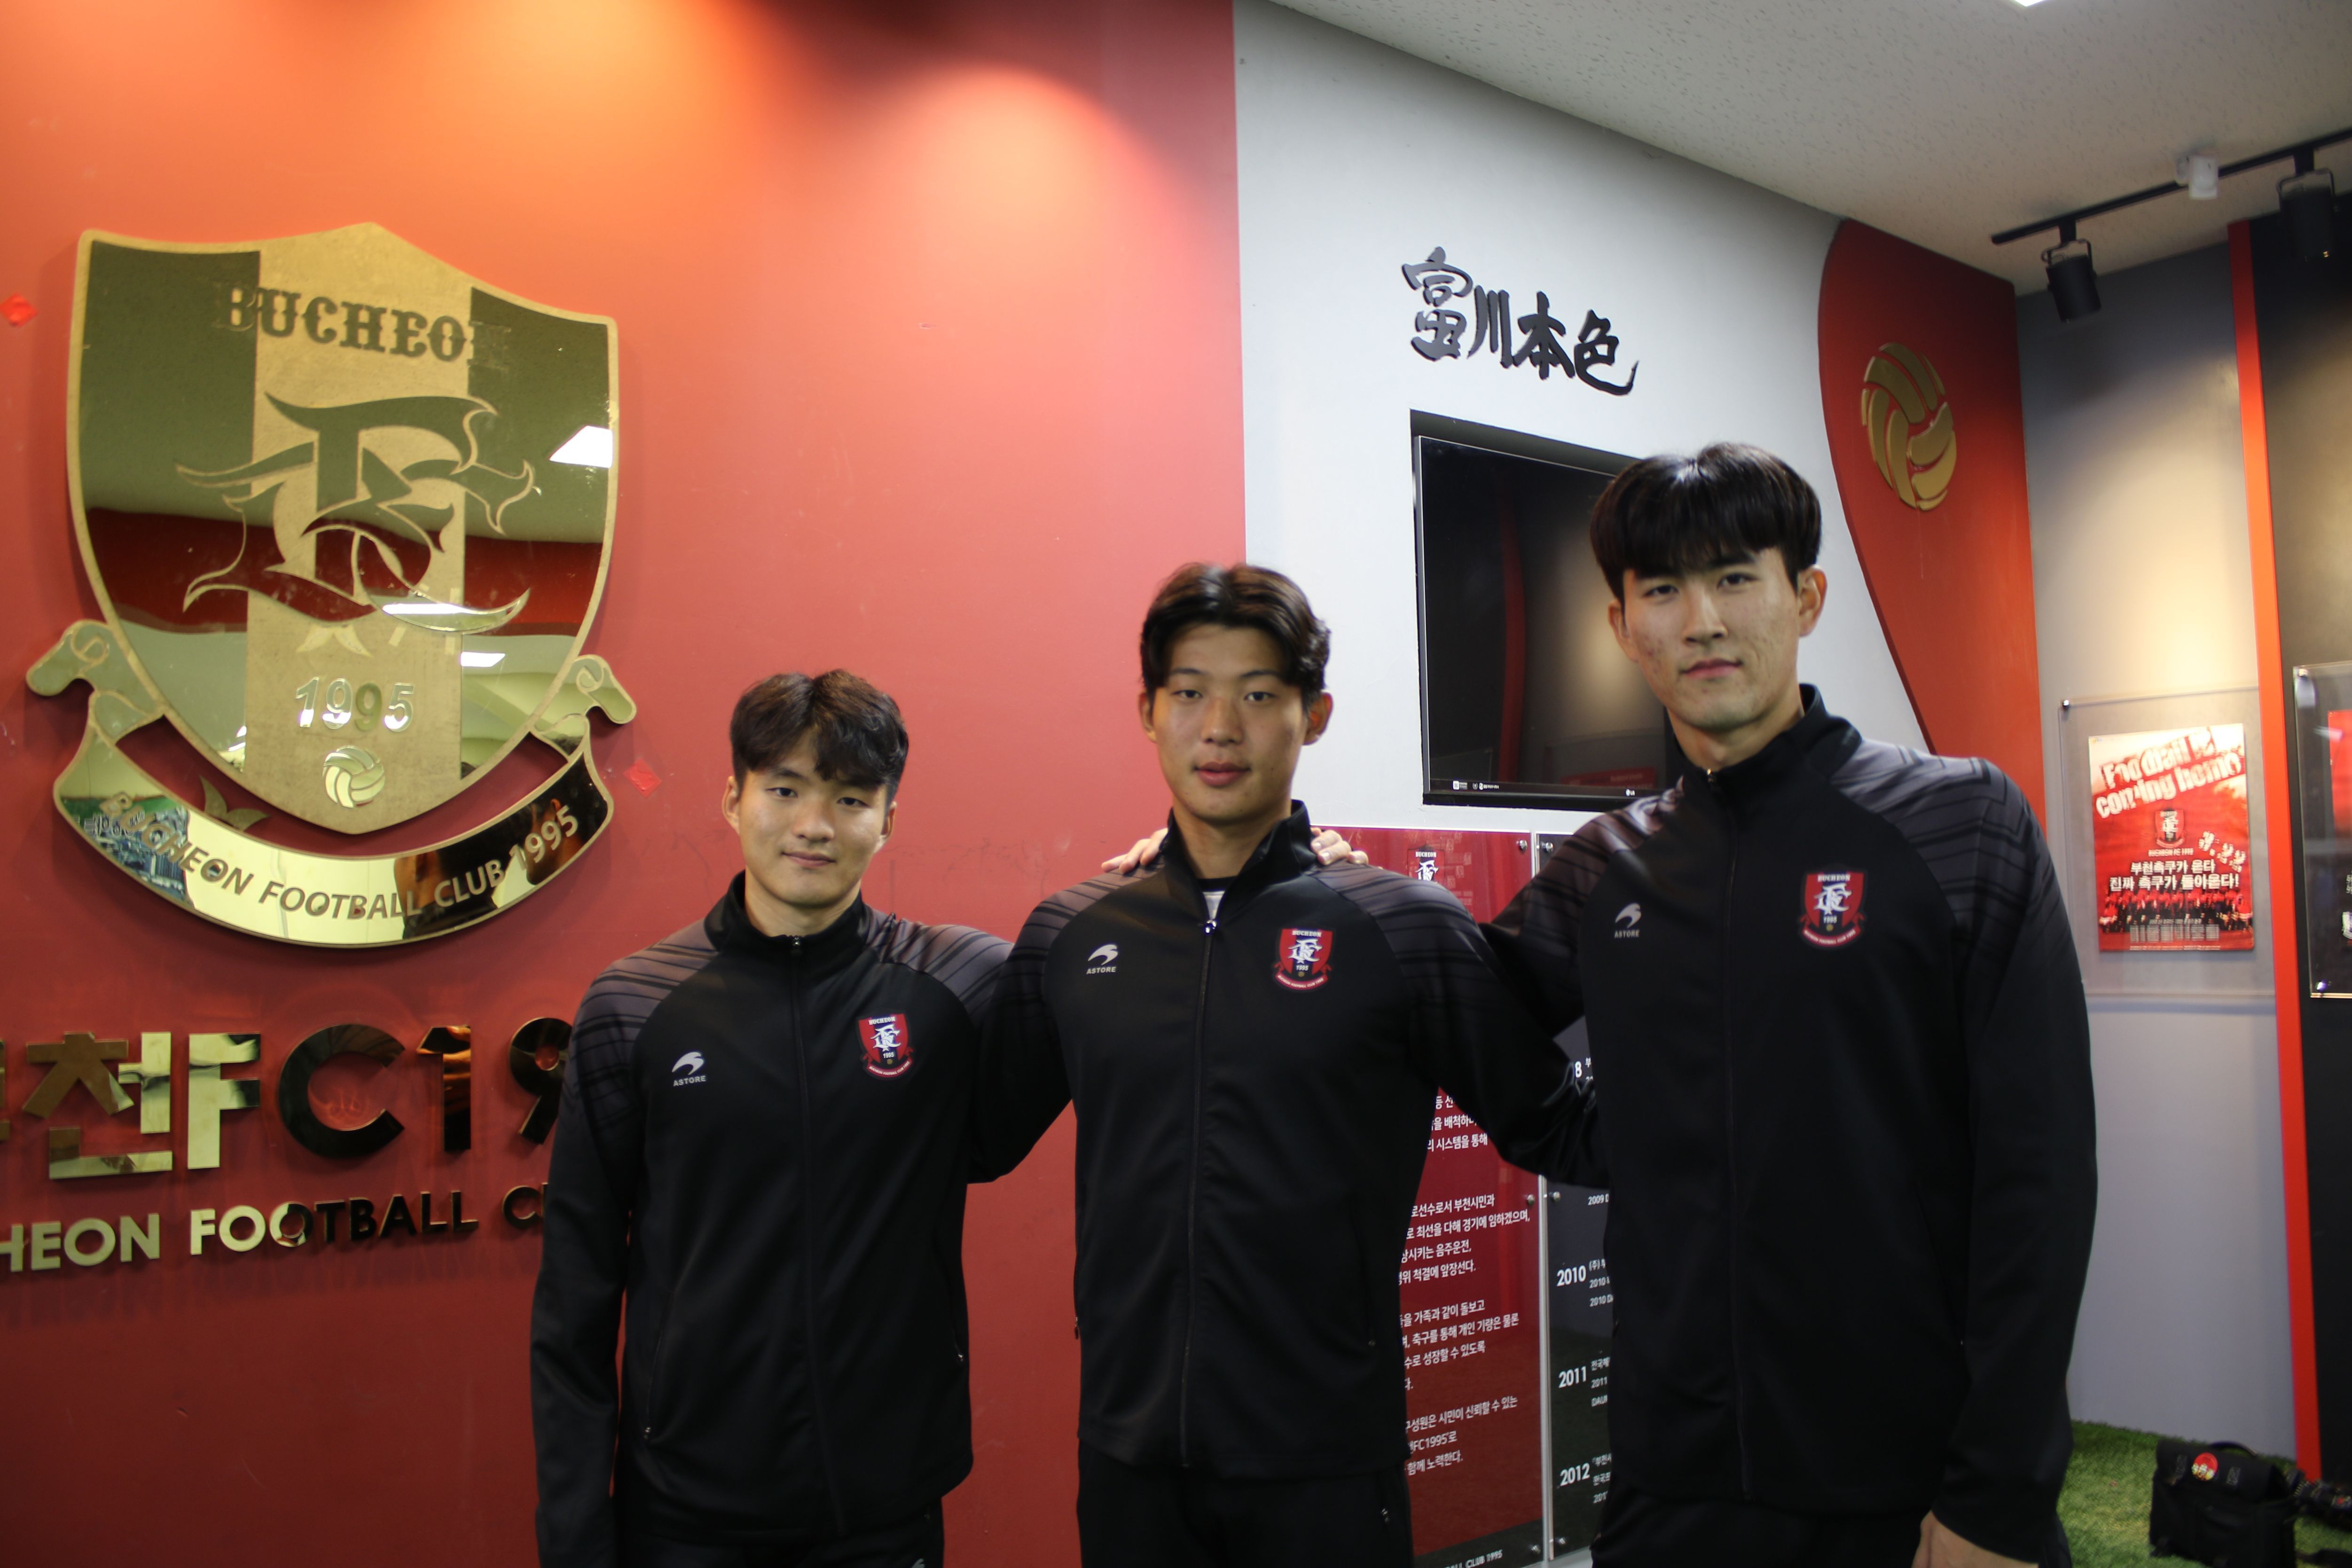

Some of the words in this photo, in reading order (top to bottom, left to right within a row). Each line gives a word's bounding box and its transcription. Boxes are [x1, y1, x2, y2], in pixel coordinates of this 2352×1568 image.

[214, 284, 511, 369] BUCHEON
[1402, 246, 1639, 396] 富川本色
[295, 677, 414, 732] 1995
[99, 792, 254, 894] BUCHEON
[258, 880, 422, 921] FOOTBALL
[434, 859, 506, 908] CLUB
[509, 805, 579, 871] 1995
[1086, 966, 1116, 975] ASTORE
[869, 1016, 896, 1025] BUCHEON
[673, 1075, 706, 1087] ASTORE
[0, 1017, 573, 1180] 천FC19
[1432, 1117, 1443, 1131] 을
[1436, 1135, 1469, 1151] 시스템을
[1471, 1133, 1488, 1147] 통해
[1454, 1194, 1495, 1212] 부천시민과
[1588, 1193, 1604, 1206] 2009
[190, 1190, 478, 1255] FOOTBALL
[1416, 1223, 1442, 1239] 최선을
[1444, 1220, 1461, 1234] 다해
[1463, 1215, 1487, 1232] 경기에
[1488, 1209, 1530, 1228] 임하겠으며,
[1435, 1239, 1472, 1258] 음주운전,
[1413, 1265, 1439, 1282] 척결에
[1440, 1259, 1476, 1278] 앞장선다.
[1557, 1265, 1586, 1286] 2010
[1589, 1277, 1606, 1289] 2010
[1414, 1308, 1440, 1324] 가족과
[1442, 1303, 1459, 1320] 같이
[1460, 1299, 1485, 1316] 돌보고
[1590, 1295, 1607, 1307] 2010
[1412, 1329, 1438, 1346] 축구를
[1440, 1325, 1458, 1341] 통해
[1458, 1321, 1475, 1336] 개인
[1477, 1317, 1501, 1333] 기량은
[1503, 1313, 1519, 1327] 물론
[1423, 1348, 1449, 1366] 성장할
[1450, 1347, 1459, 1359] 수
[1460, 1340, 1486, 1358] 있도록
[1558, 1366, 1586, 1388] 2011
[1591, 1376, 1607, 1388] 2011
[1438, 1407, 1464, 1425] 시민이
[1465, 1401, 1490, 1419] 신뢰할
[1491, 1399, 1500, 1411] 수
[1501, 1396, 1518, 1410] 있는
[1407, 1458, 1426, 1476] 함께
[1427, 1450, 1464, 1470] 노력한다.
[1560, 1462, 1590, 1487] 2012
